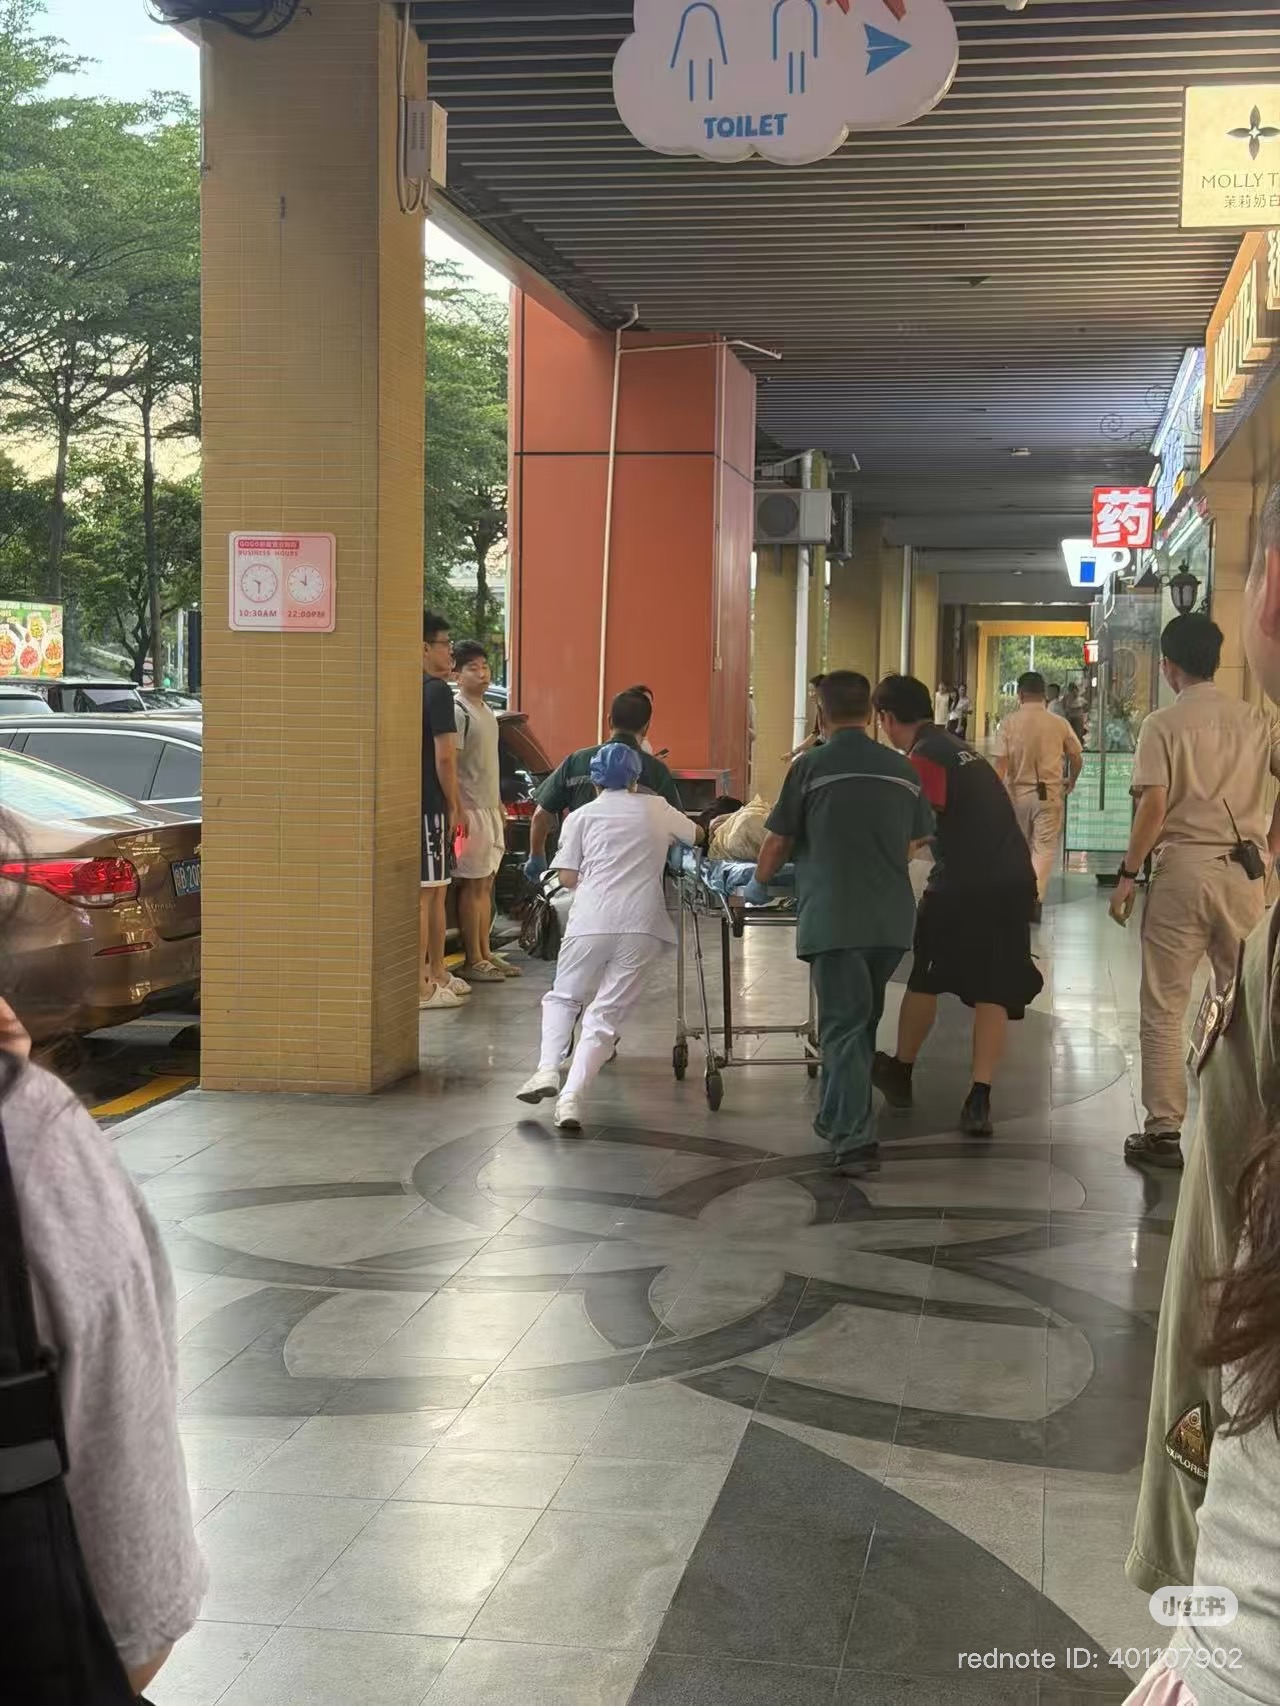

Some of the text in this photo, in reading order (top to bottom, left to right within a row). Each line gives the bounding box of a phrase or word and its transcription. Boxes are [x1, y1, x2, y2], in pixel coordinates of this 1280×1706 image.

[704, 113, 788, 139] TOILET
[1201, 172, 1263, 189] MOLLY
[1224, 193, 1280, 209] 茉莉奶白
[1096, 489, 1151, 546] 药
[239, 609, 277, 618] 10:30AM
